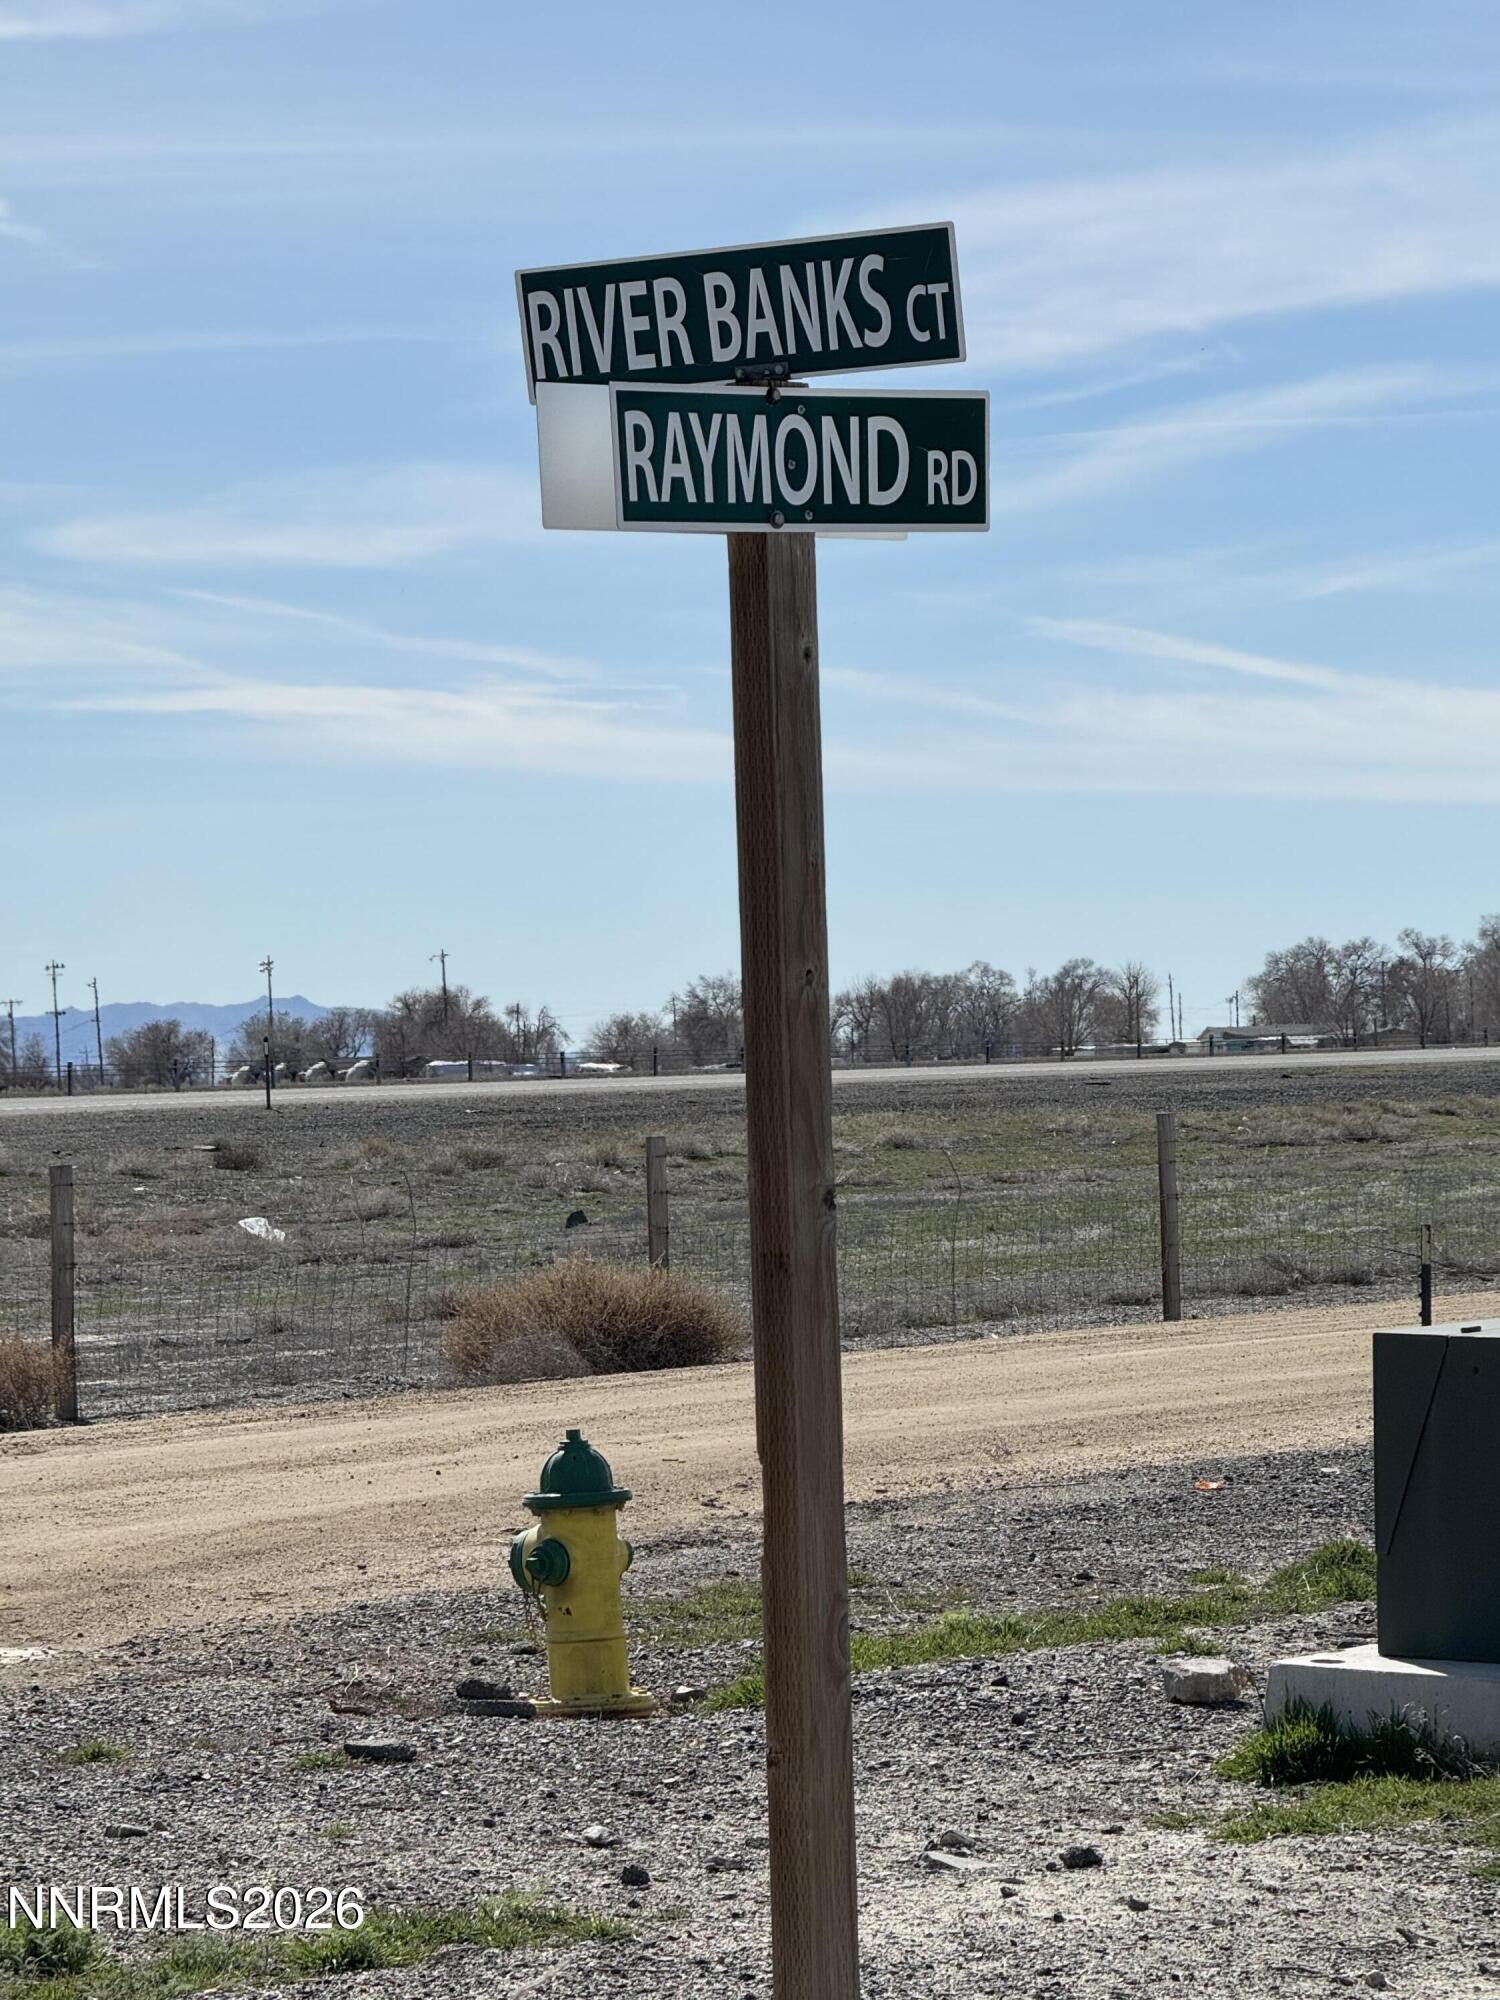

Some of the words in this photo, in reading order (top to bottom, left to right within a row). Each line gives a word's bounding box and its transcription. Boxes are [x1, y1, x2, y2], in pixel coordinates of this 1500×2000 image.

[528, 277, 695, 379] RIVER
[704, 254, 892, 362] BANKS
[906, 282, 949, 343] CT
[624, 410, 910, 506] RAYMOND
[927, 450, 978, 506] RD
